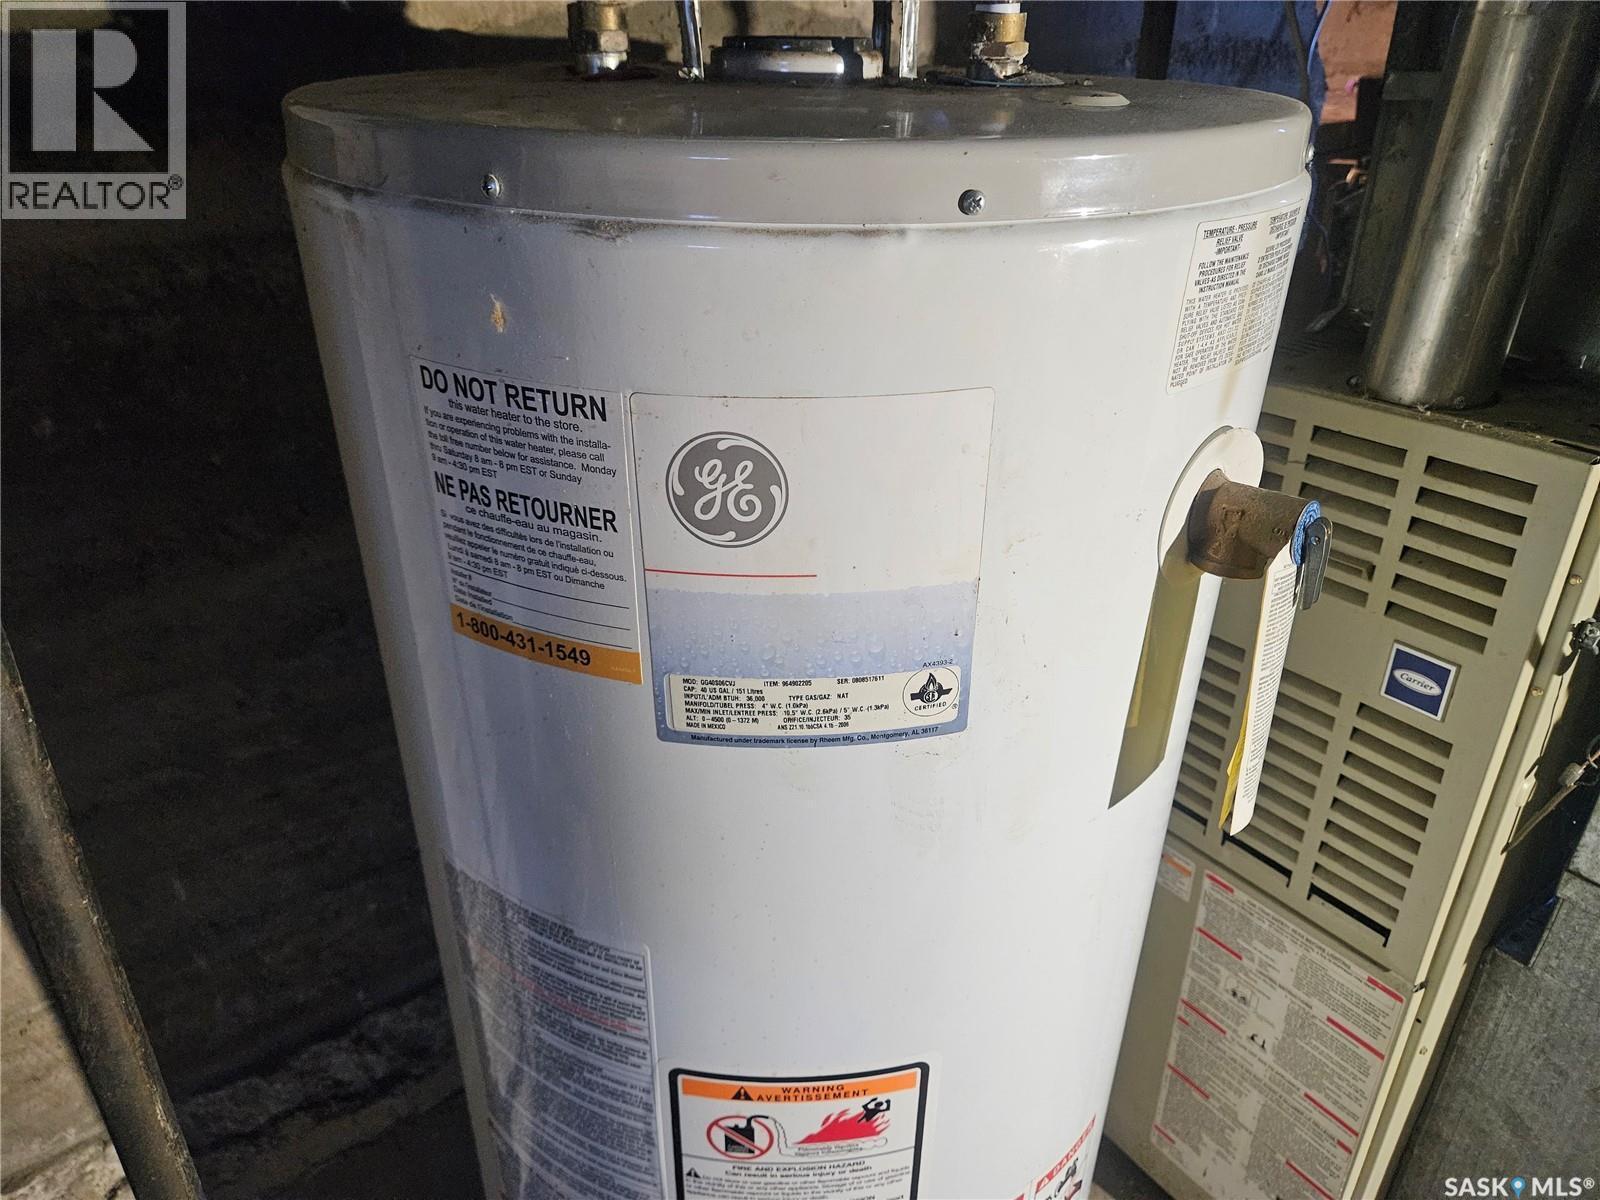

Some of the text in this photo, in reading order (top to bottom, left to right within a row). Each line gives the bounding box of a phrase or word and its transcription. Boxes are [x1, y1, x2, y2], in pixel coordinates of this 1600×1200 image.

[1203, 225, 1235, 239] TEMPERATURE
[1238, 221, 1258, 232] PRESSURE
[420, 365, 607, 422] DO NOT RETURN
[448, 399, 583, 432] this water heater to the store.
[446, 425, 478, 439] operation
[480, 433, 487, 441] of
[488, 434, 503, 445] this
[504, 439, 526, 450] water
[528, 441, 556, 455] heater,
[559, 447, 587, 460] please
[589, 453, 605, 462] call
[455, 416, 501, 434] experiencing
[503, 426, 539, 440] problems
[541, 432, 558, 443] with
[560, 435, 574, 445] the
[576, 437, 612, 450] installa-
[465, 442, 491, 453] number
[493, 447, 516, 459] below
[518, 452, 528, 461] for
[530, 456, 576, 470] assistance.
[581, 462, 617, 478] Monday
[469, 466, 480, 474] pm
[482, 467, 497, 478] EST
[506, 463, 518, 472] pm
[520, 464, 537, 476] EST
[539, 468, 547, 477] or
[549, 470, 582, 485] Sunday
[434, 471, 456, 497] NE
[458, 478, 491, 507] PAS
[495, 488, 618, 533] RETOURNER
[465, 506, 477, 515] ce
[478, 508, 534, 529] chauffe-eau
[537, 524, 550, 533] au
[553, 526, 603, 543] magasin.
[527, 545, 536, 554] de
[537, 548, 546, 556] ce
[529, 534, 543, 544] lors
[544, 538, 554, 546] de
[556, 540, 602, 556] l'installation
[603, 550, 614, 558] ou
[527, 556, 550, 569] gratuit
[524, 567, 535, 576] pm
[536, 569, 552, 580] EST
[554, 574, 563, 582] ou
[565, 575, 605, 590] Dimanche
[456, 611, 592, 667] 1-800-431-1549
[1400, 672, 1435, 691] Carrier
[914, 701, 947, 711] CERTIFIED
[690, 734, 733, 743] Manufactured
[786, 736, 809, 744] license
[809, 736, 818, 746] by
[870, 731, 909, 740] Montgomery,
[921, 726, 939, 734] 36117
[757, 1088, 869, 1102] AVERTISSEMENT
[781, 1084, 845, 1094] WARNING
